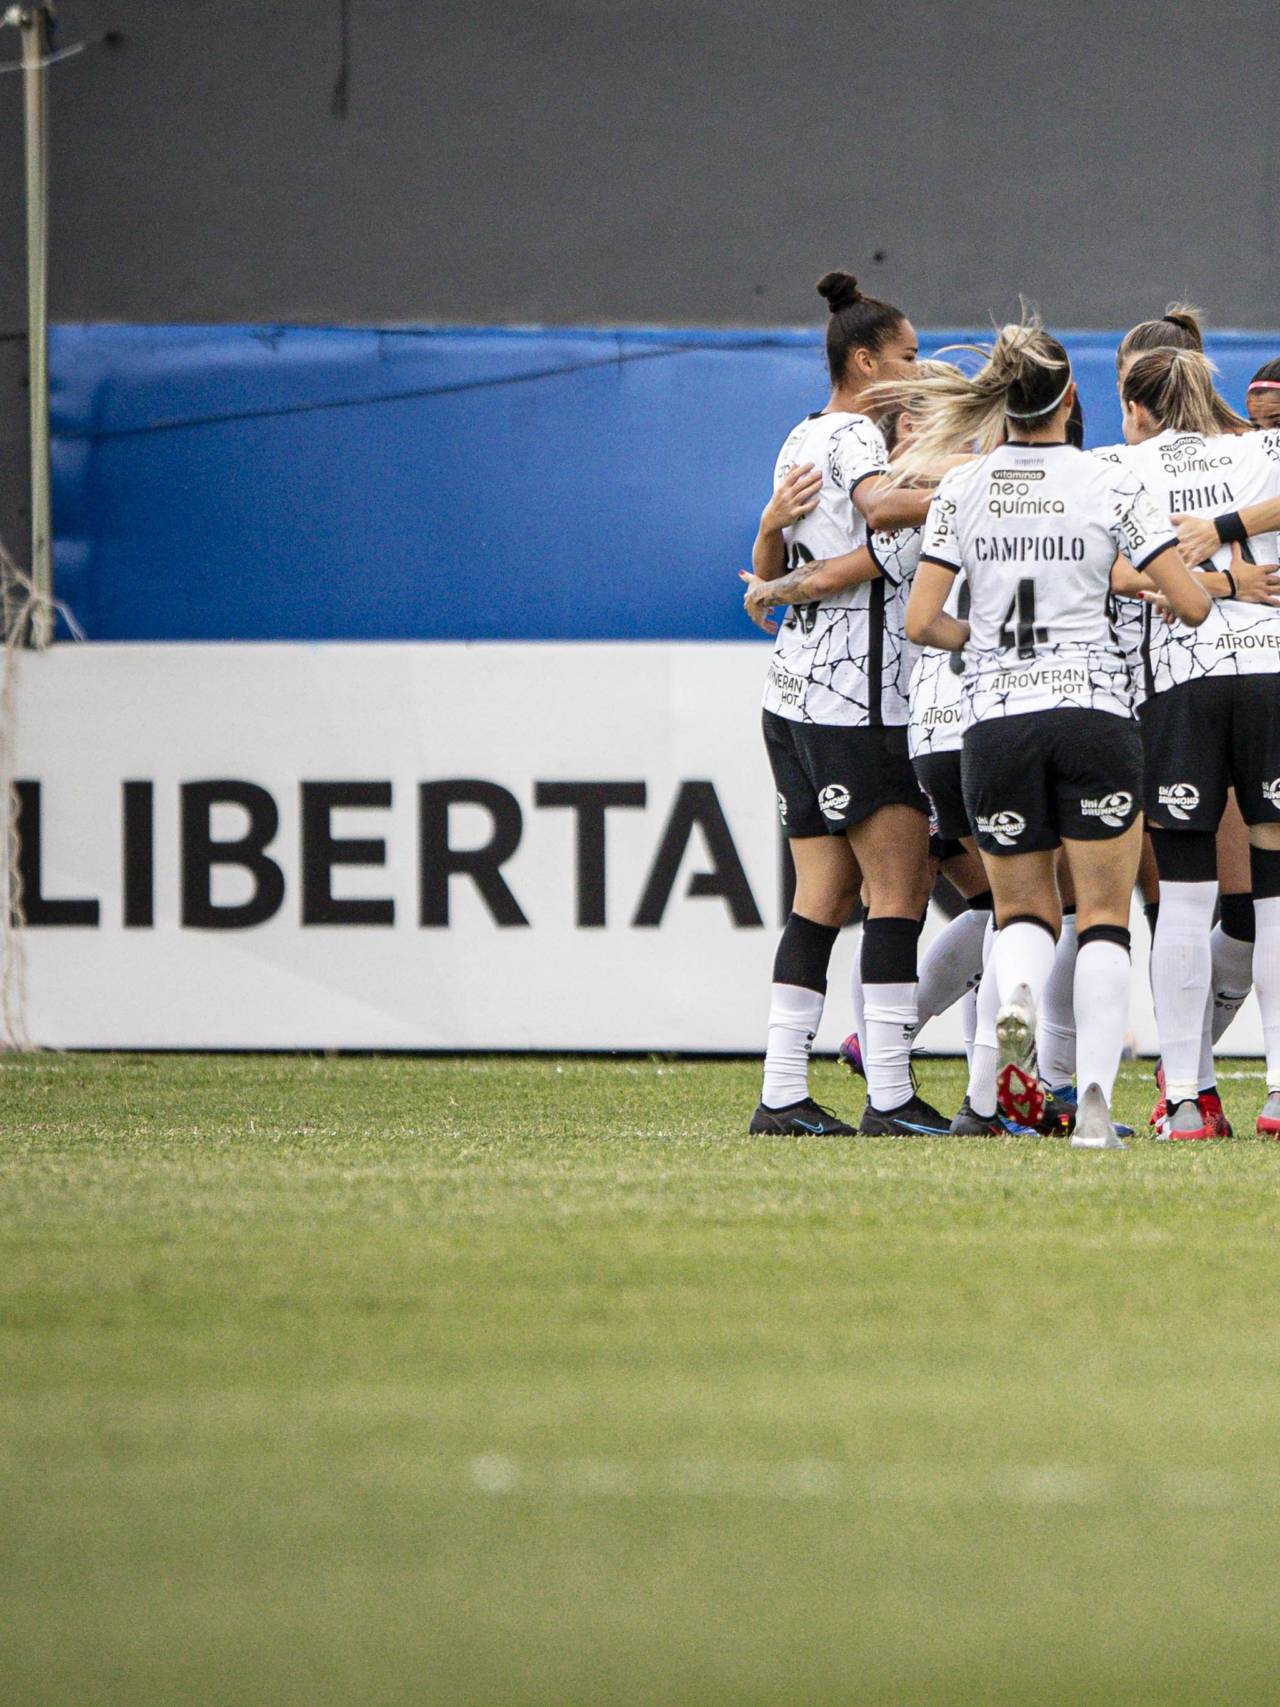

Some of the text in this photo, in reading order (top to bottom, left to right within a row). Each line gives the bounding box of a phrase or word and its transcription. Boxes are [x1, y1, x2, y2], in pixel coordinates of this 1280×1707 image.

[1161, 446, 1197, 461] neo
[994, 471, 1043, 480] vitaminas
[990, 482, 1029, 496] neo
[1169, 482, 1235, 514] ERIKA
[989, 497, 1065, 519] química
[975, 536, 1085, 562] CAMPIOLO
[1000, 578, 1048, 660] 4
[989, 668, 1086, 692] ATROVERAN
[1052, 683, 1084, 695] HOT
[781, 690, 800, 706] HOT
[921, 706, 963, 726] ATROV
[10, 779, 796, 930] LIBERTA
